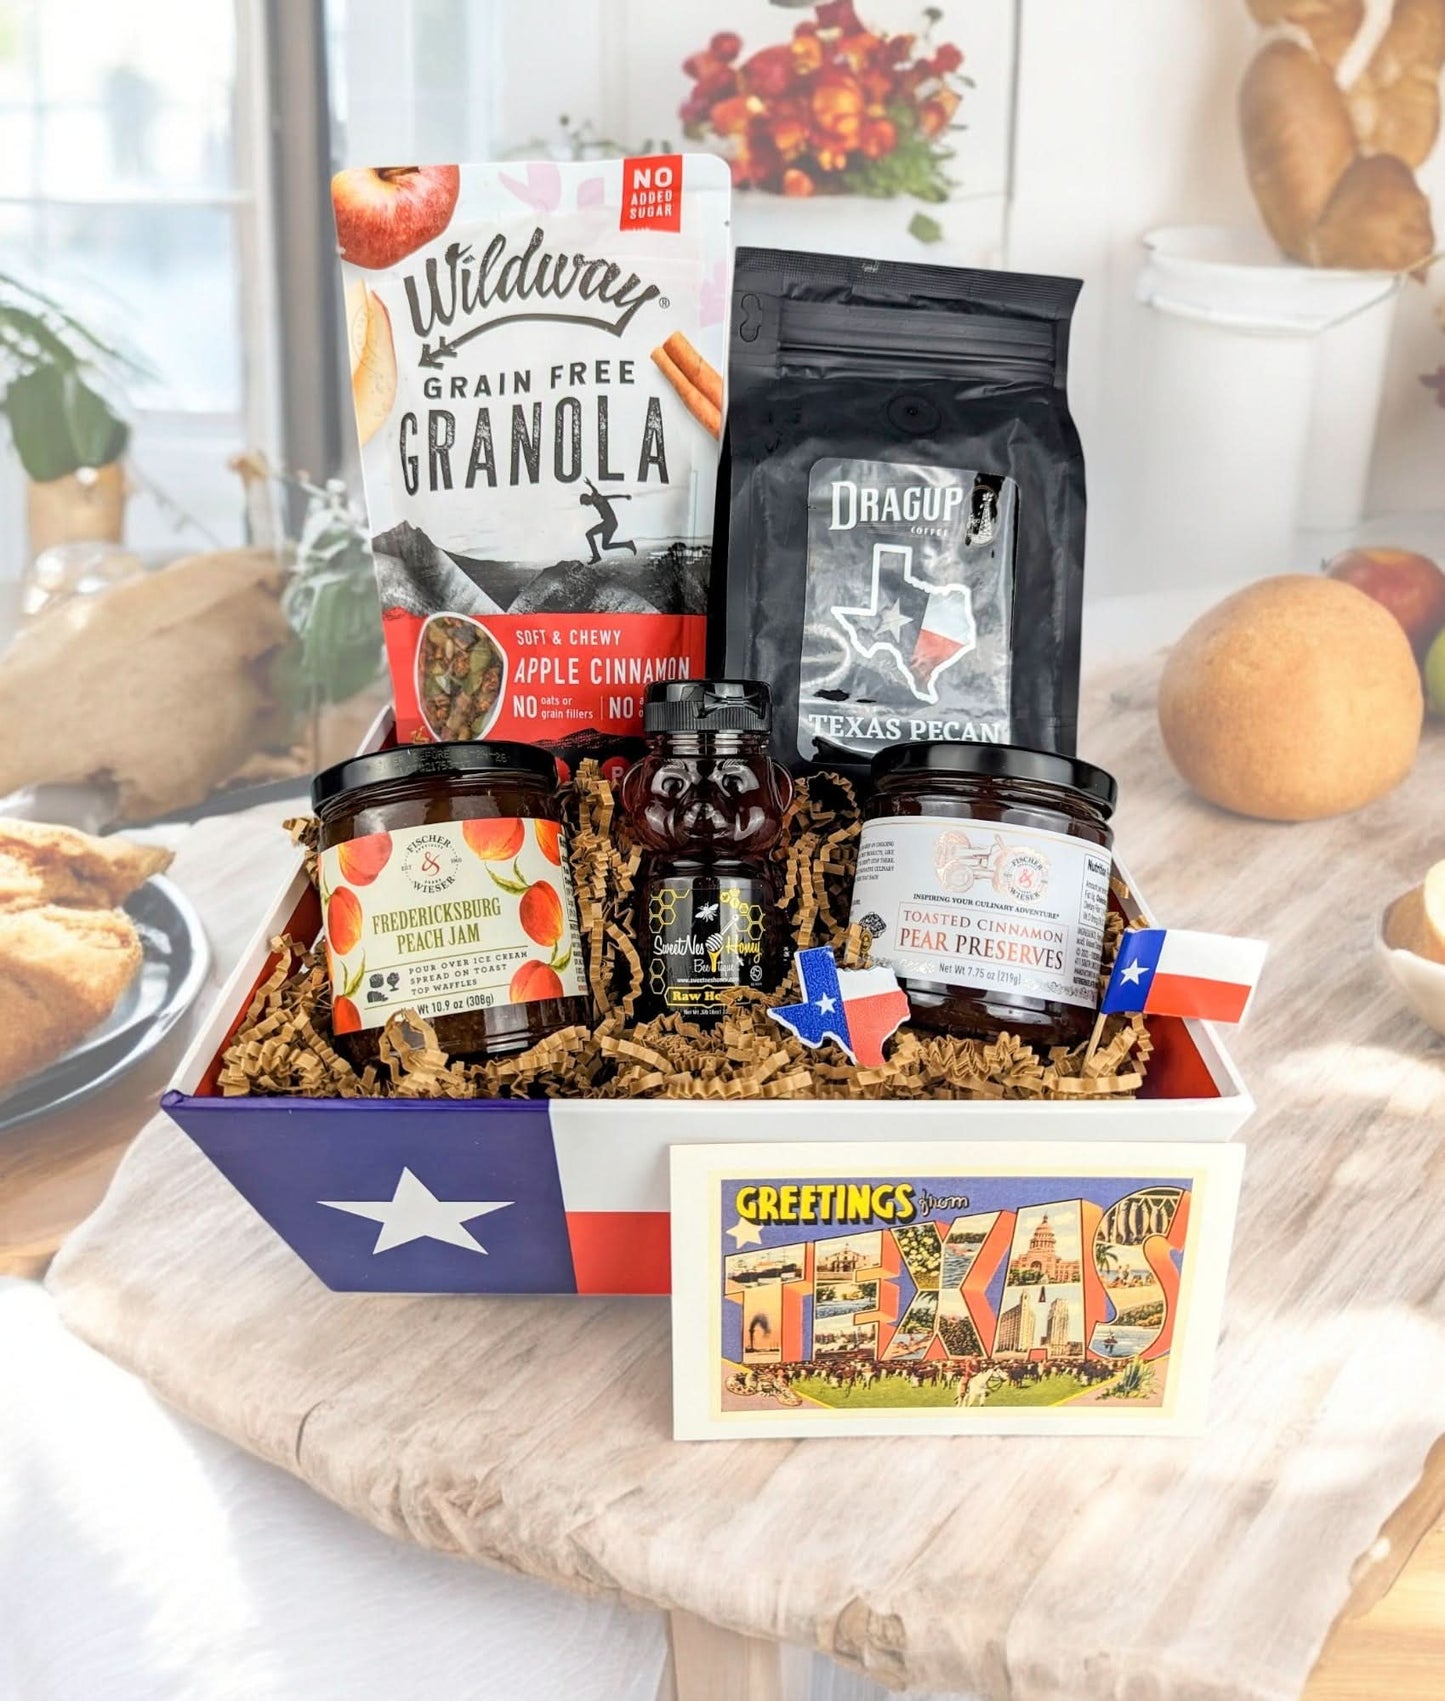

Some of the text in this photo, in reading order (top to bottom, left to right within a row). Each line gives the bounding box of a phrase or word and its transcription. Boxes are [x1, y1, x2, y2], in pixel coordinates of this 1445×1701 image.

[633, 166, 673, 190] NO
[631, 189, 672, 206] ADDED
[629, 203, 672, 220] SUGAR
[403, 227, 661, 337] Wildway
[423, 360, 636, 399] GRAIN FREE
[400, 395, 670, 496] GRANOLA
[828, 480, 964, 531] DRAGUP
[910, 526, 950, 537] COFFEE
[516, 629, 621, 646] SOFT & CHEWY
[514, 656, 690, 685] APPLE CINNAMON
[513, 695, 573, 719] NO oats or
[541, 708, 593, 721] grain fillers
[609, 696, 634, 720] NO
[808, 714, 1000, 743] TEXAS PECAN
[406, 834, 451, 853] FISCHER
[421, 851, 441, 877] &
[414, 876, 456, 893] WIESER
[913, 893, 951, 904] INSPIRING
[952, 896, 974, 906] YOUR
[975, 899, 1013, 913] CULINARY
[372, 897, 501, 935] FREDERICKSBURG
[903, 909, 971, 928] TOASTED
[977, 919, 1064, 944] CINNAMON
[396, 922, 480, 955] PEACH JAM
[653, 934, 705, 956] SweetNes
[725, 933, 763, 964] Honey
[900, 927, 949, 952] PEAR
[955, 933, 1064, 971] PRESERVES
[409, 951, 528, 975] POUR OVER ICE CREAM
[410, 963, 508, 986] SPREAD ON TOAST
[694, 958, 710, 973] Bee
[939, 963, 1021, 987] Net Wt 7.75 oz (219g)
[411, 978, 478, 996] TOP WAFFLES
[672, 990, 702, 1002] Raw
[417, 1004, 429, 1016] Wt
[431, 1000, 450, 1014] 10.9
[453, 1000, 464, 1009] oz
[466, 993, 494, 1009] (308g)
[735, 1182, 970, 1226] GREETINGS from
[723, 1185, 1192, 1364] TEXAS
